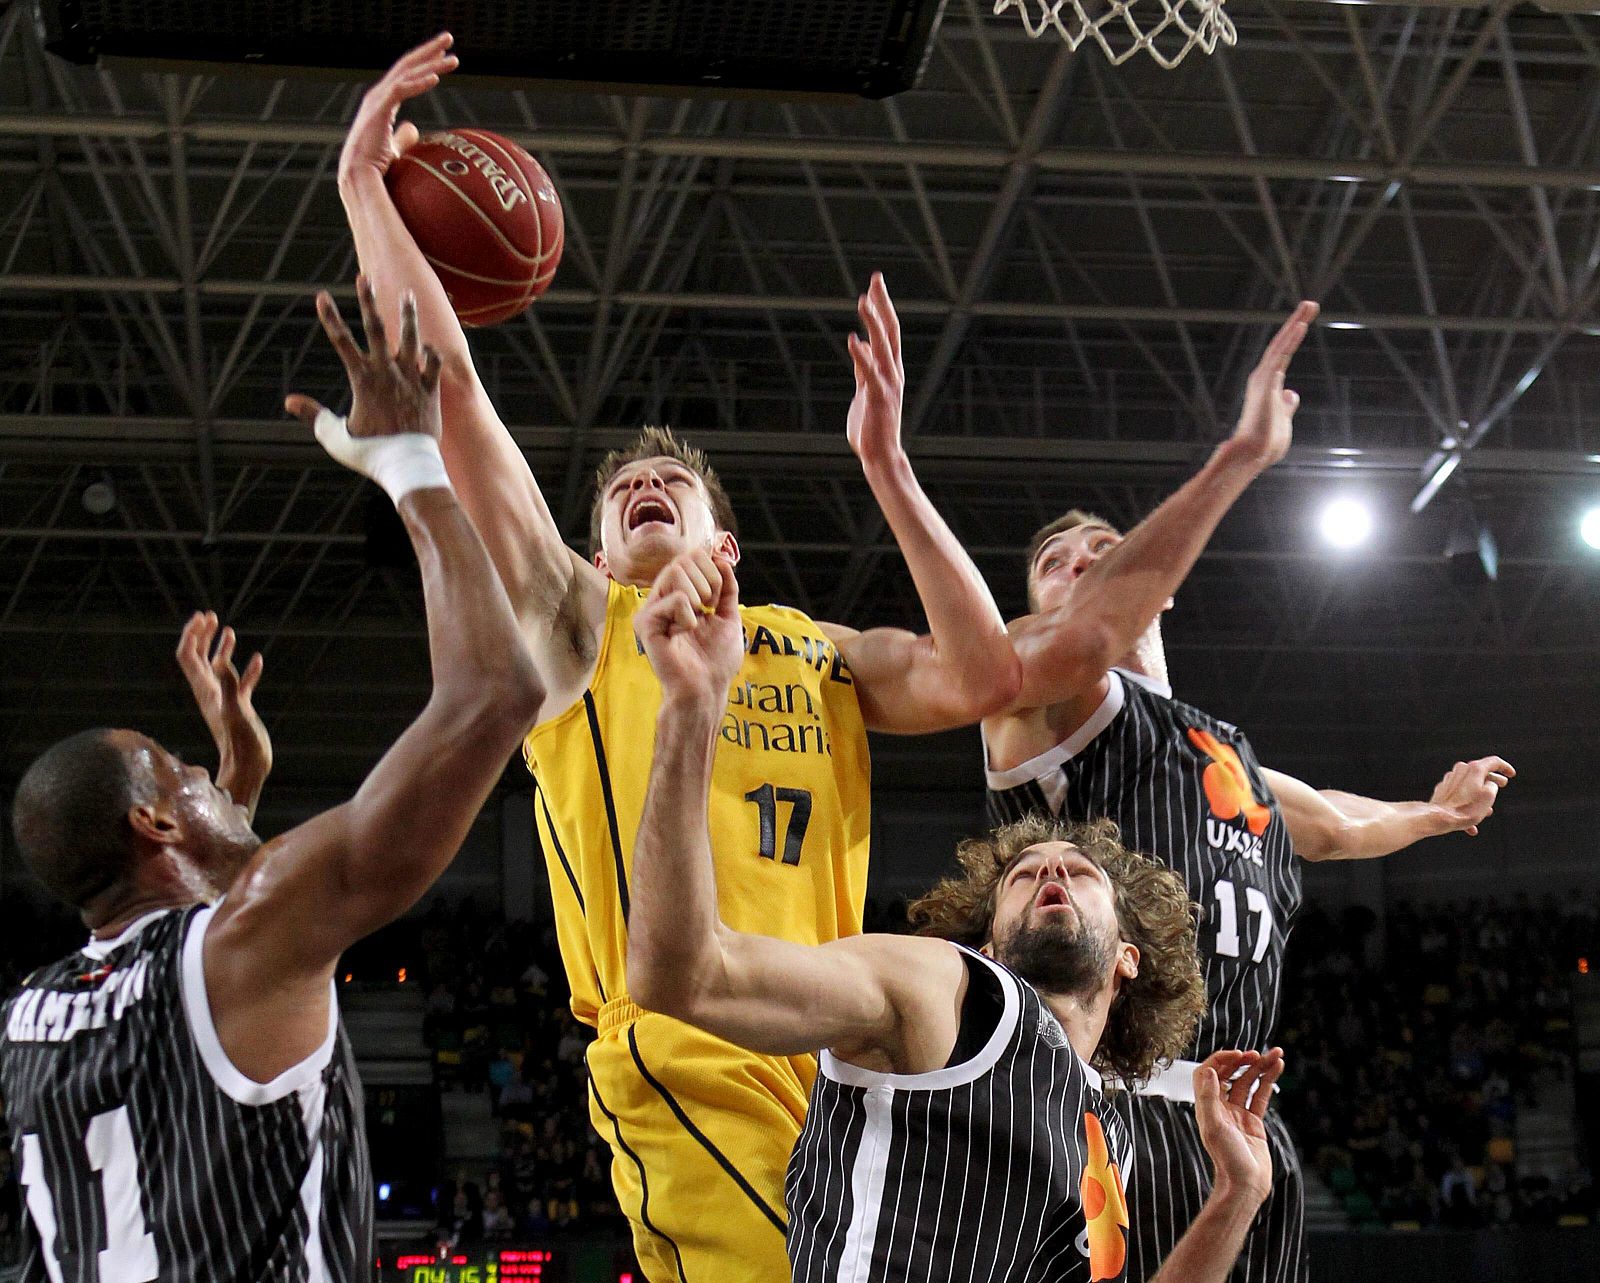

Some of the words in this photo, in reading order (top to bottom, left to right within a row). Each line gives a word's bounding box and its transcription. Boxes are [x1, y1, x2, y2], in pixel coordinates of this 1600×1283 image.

[720, 712, 832, 757] anari
[744, 782, 812, 867] 17
[1214, 879, 1273, 964] 17
[21, 1104, 159, 1283] 11
